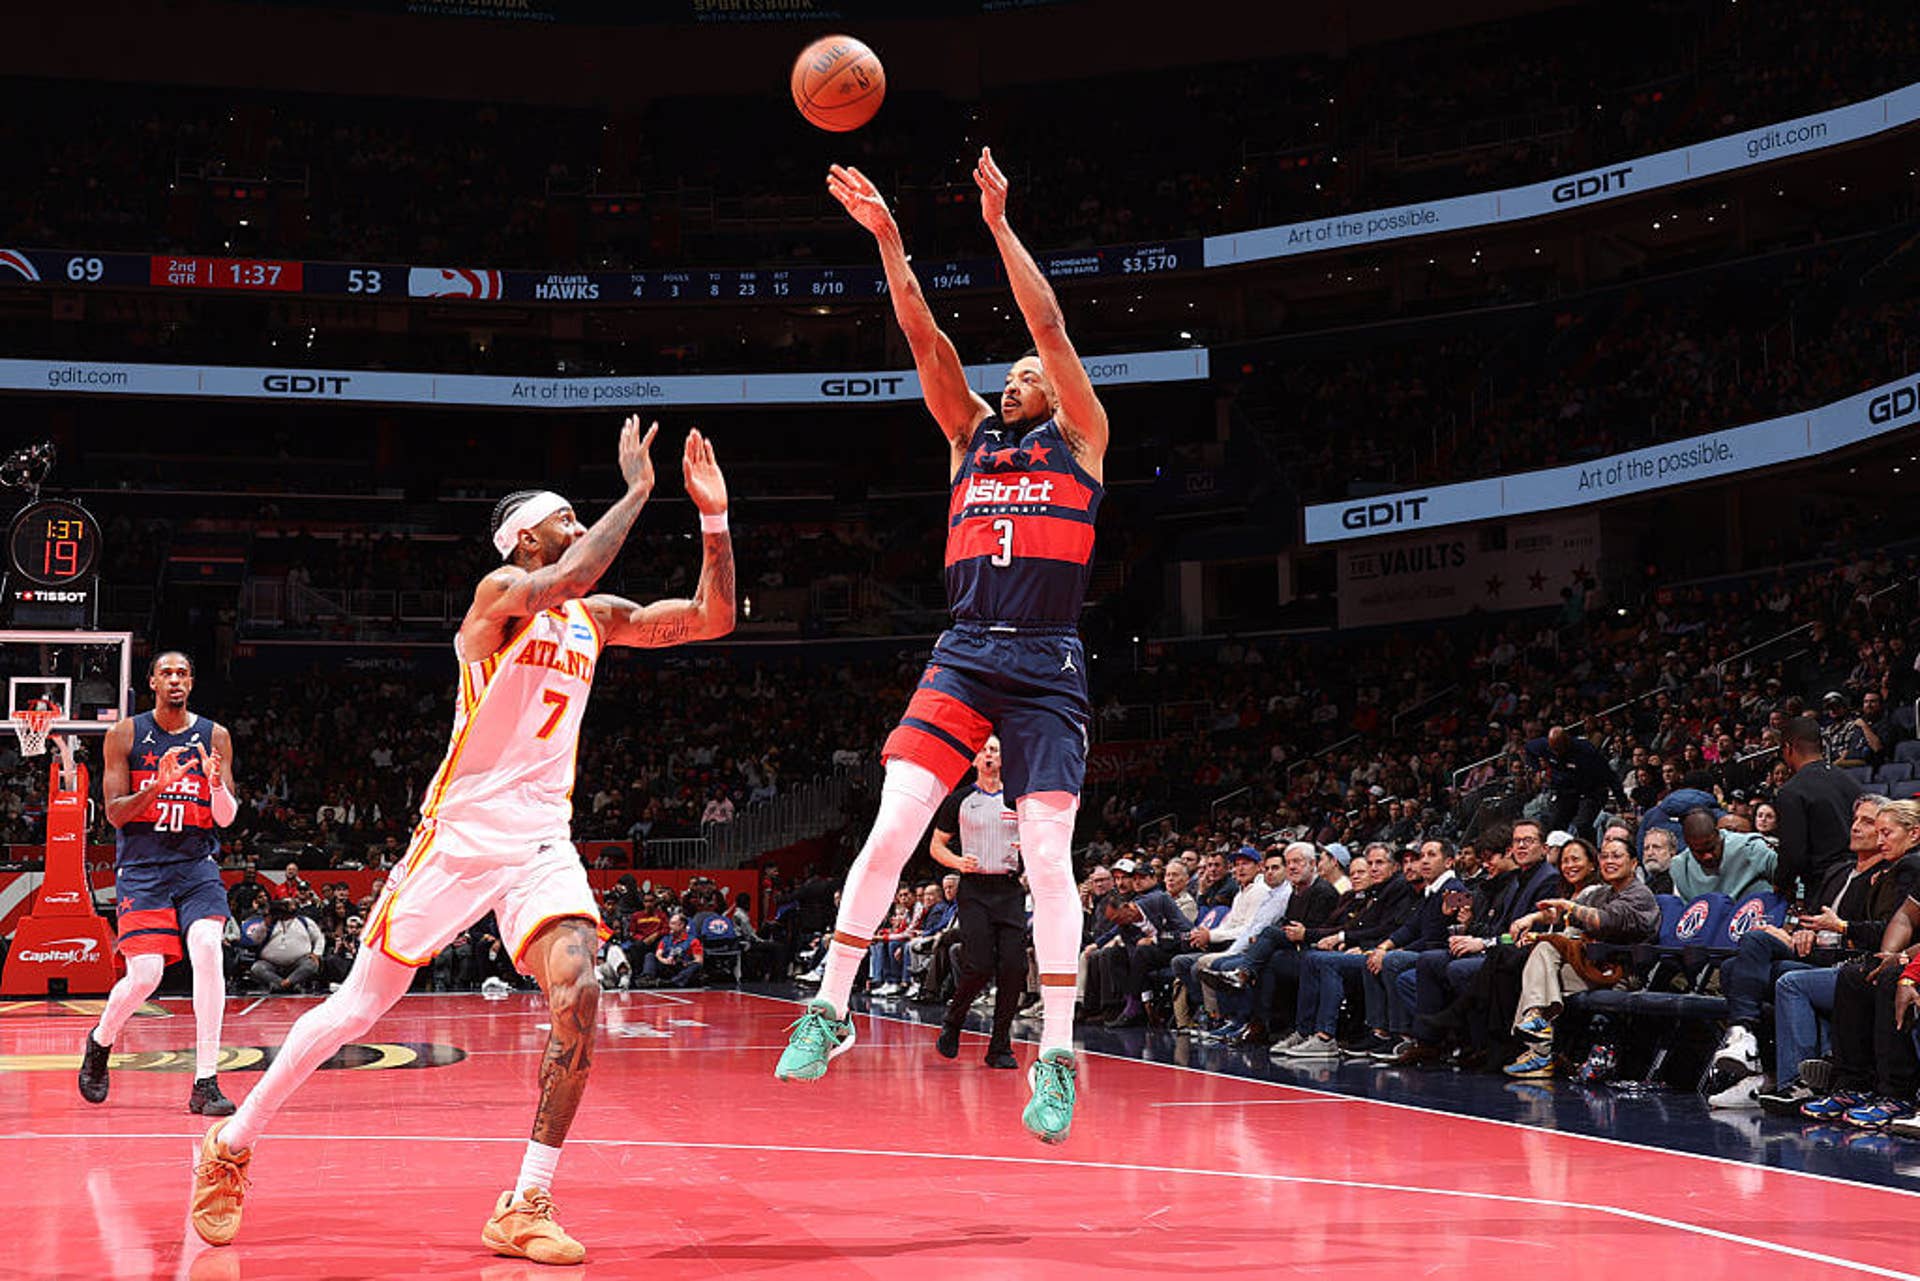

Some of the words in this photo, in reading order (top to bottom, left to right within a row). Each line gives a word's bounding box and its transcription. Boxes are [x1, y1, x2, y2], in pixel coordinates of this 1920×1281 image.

[1747, 122, 1827, 158] gdit.com
[1552, 167, 1632, 203] GDIT
[1288, 229, 1311, 245] Art
[1315, 222, 1331, 240] of
[1337, 219, 1362, 236] the
[1368, 209, 1440, 236] possible.
[66, 257, 104, 281] 69
[169, 260, 196, 272] 2nd
[230, 264, 282, 285] 1:37
[1121, 254, 1178, 275] $3,570
[169, 273, 196, 284] QTR
[347, 269, 381, 294] 53
[633, 285, 643, 297] 4
[671, 285, 680, 297] 3
[709, 285, 720, 297] 8
[739, 284, 757, 297] 23
[774, 283, 790, 296] 15
[812, 281, 845, 295] 8/10
[932, 273, 971, 289] 19/44
[536, 284, 600, 300] HAWKS
[48, 366, 128, 387] gdit.com
[263, 374, 350, 396] GDIT
[820, 376, 904, 397] GDIT
[512, 382, 536, 398] Art
[540, 381, 559, 399] of
[563, 382, 589, 399] the
[592, 381, 664, 402] possible.
[1578, 469, 1602, 491] Art
[1606, 461, 1622, 485] of
[1627, 457, 1653, 481] the
[1658, 438, 1734, 479] possible.
[1342, 497, 1428, 530] GDIT
[47, 520, 84, 540] 1:37
[991, 518, 1014, 568] 3
[44, 540, 79, 576] 19
[1379, 543, 1465, 576] VAULTS
[35, 590, 87, 603] TISSOT
[536, 688, 569, 739] 7
[154, 802, 185, 832] 20
